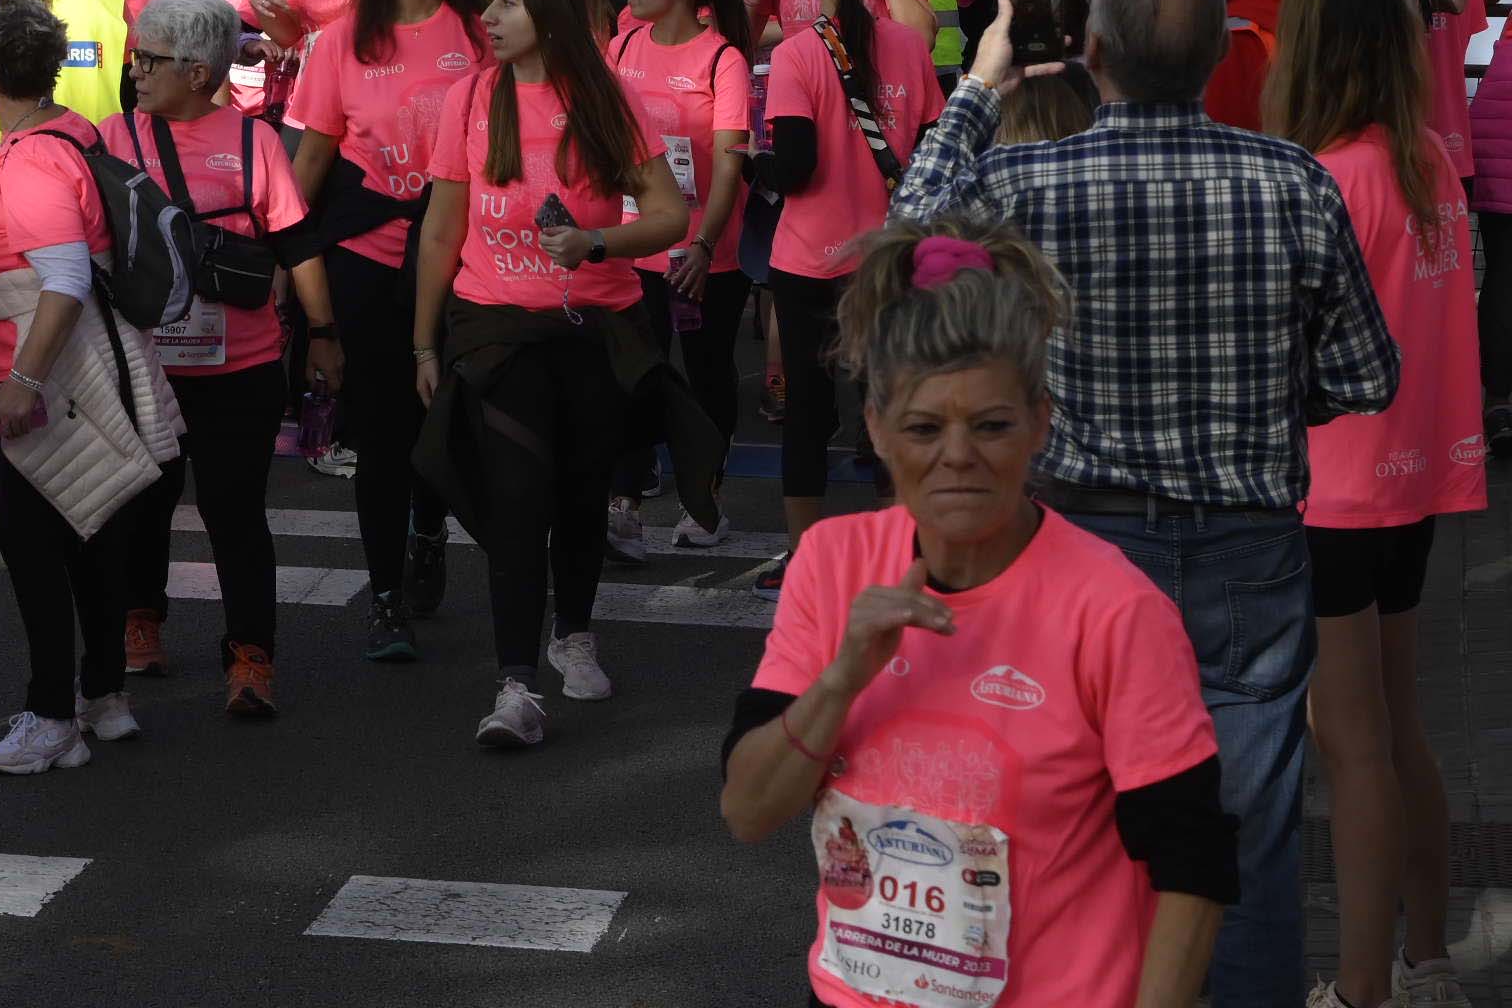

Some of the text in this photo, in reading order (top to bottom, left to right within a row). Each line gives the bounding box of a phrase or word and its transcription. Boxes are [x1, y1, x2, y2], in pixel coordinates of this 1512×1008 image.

[365, 64, 405, 80] OYSHO
[379, 143, 410, 167] TU
[480, 193, 507, 219] TU
[481, 225, 534, 249] DOR
[494, 252, 568, 274] SUMA
[878, 875, 946, 914] 016
[881, 912, 937, 940] 31878
[886, 940, 902, 953] DE
[903, 943, 919, 958] LA
[920, 949, 960, 969] MUJER
[930, 980, 996, 1003] Santander
